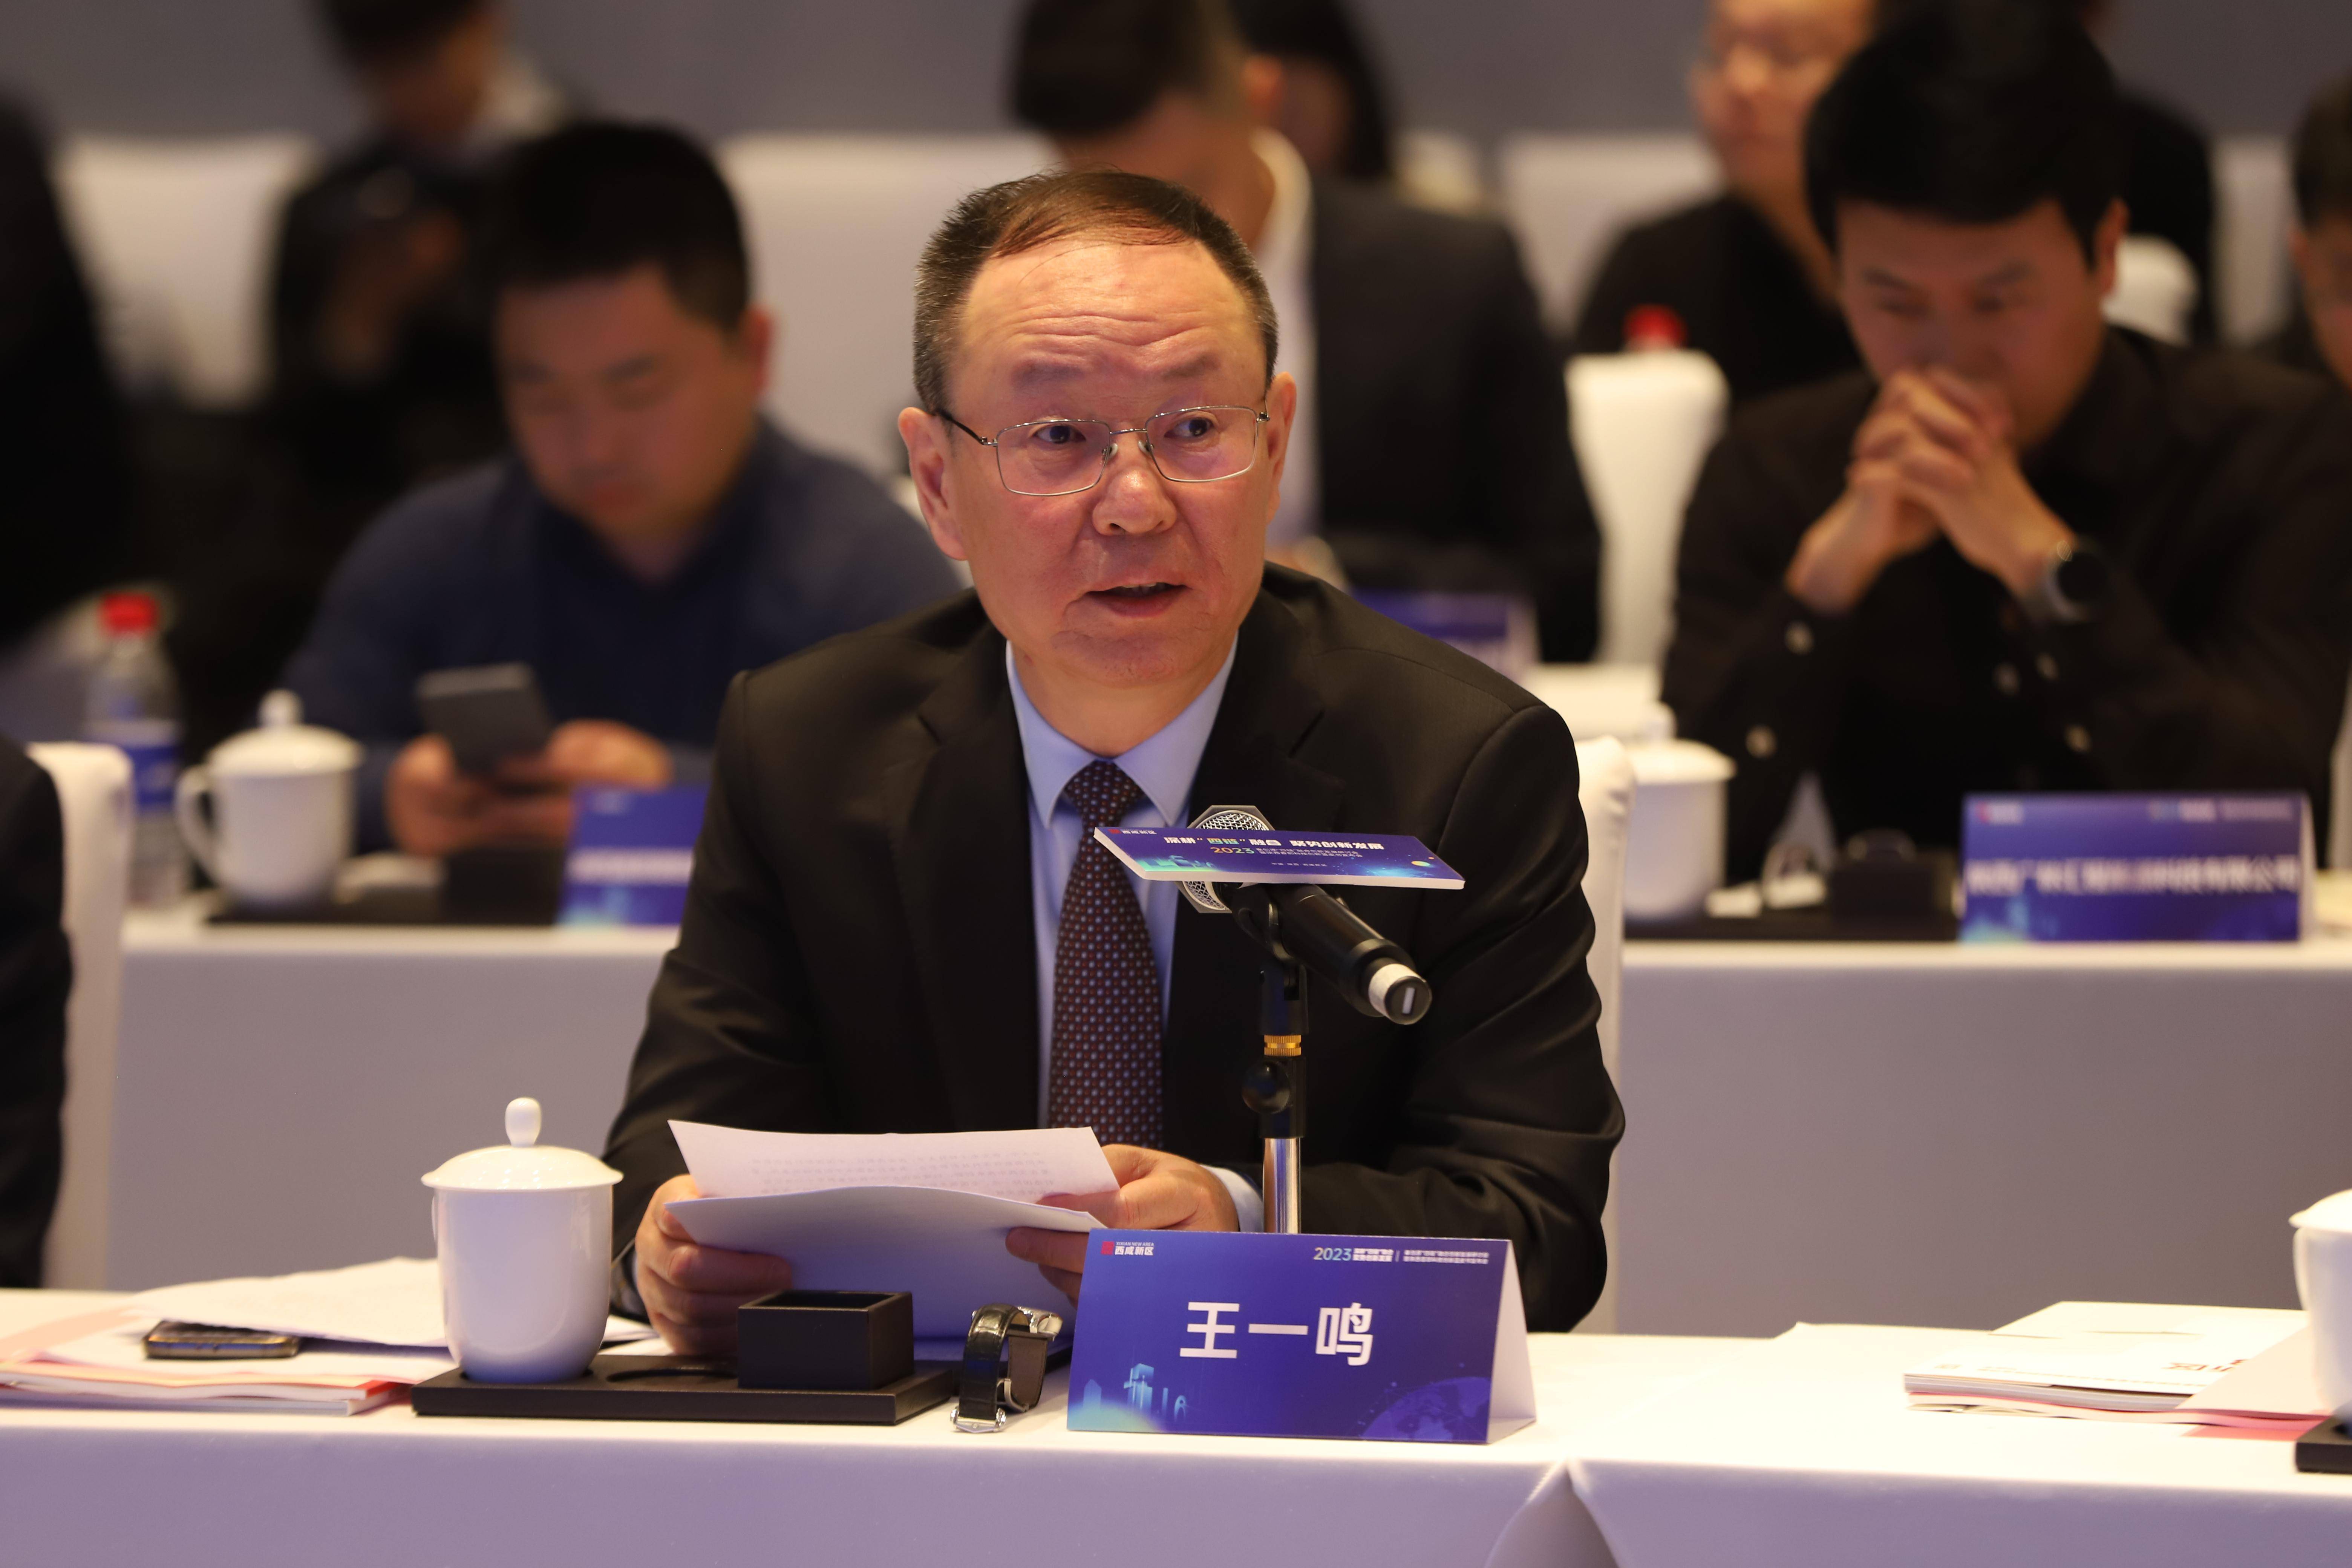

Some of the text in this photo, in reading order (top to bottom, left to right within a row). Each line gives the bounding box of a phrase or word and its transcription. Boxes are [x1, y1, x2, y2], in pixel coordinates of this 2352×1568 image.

[1289, 840, 1384, 850] 聚势创新发展
[1115, 1246, 1154, 1256] 西咸新区
[1313, 1247, 1352, 1261] 2023
[1180, 1302, 1373, 1366] 王一鸣
